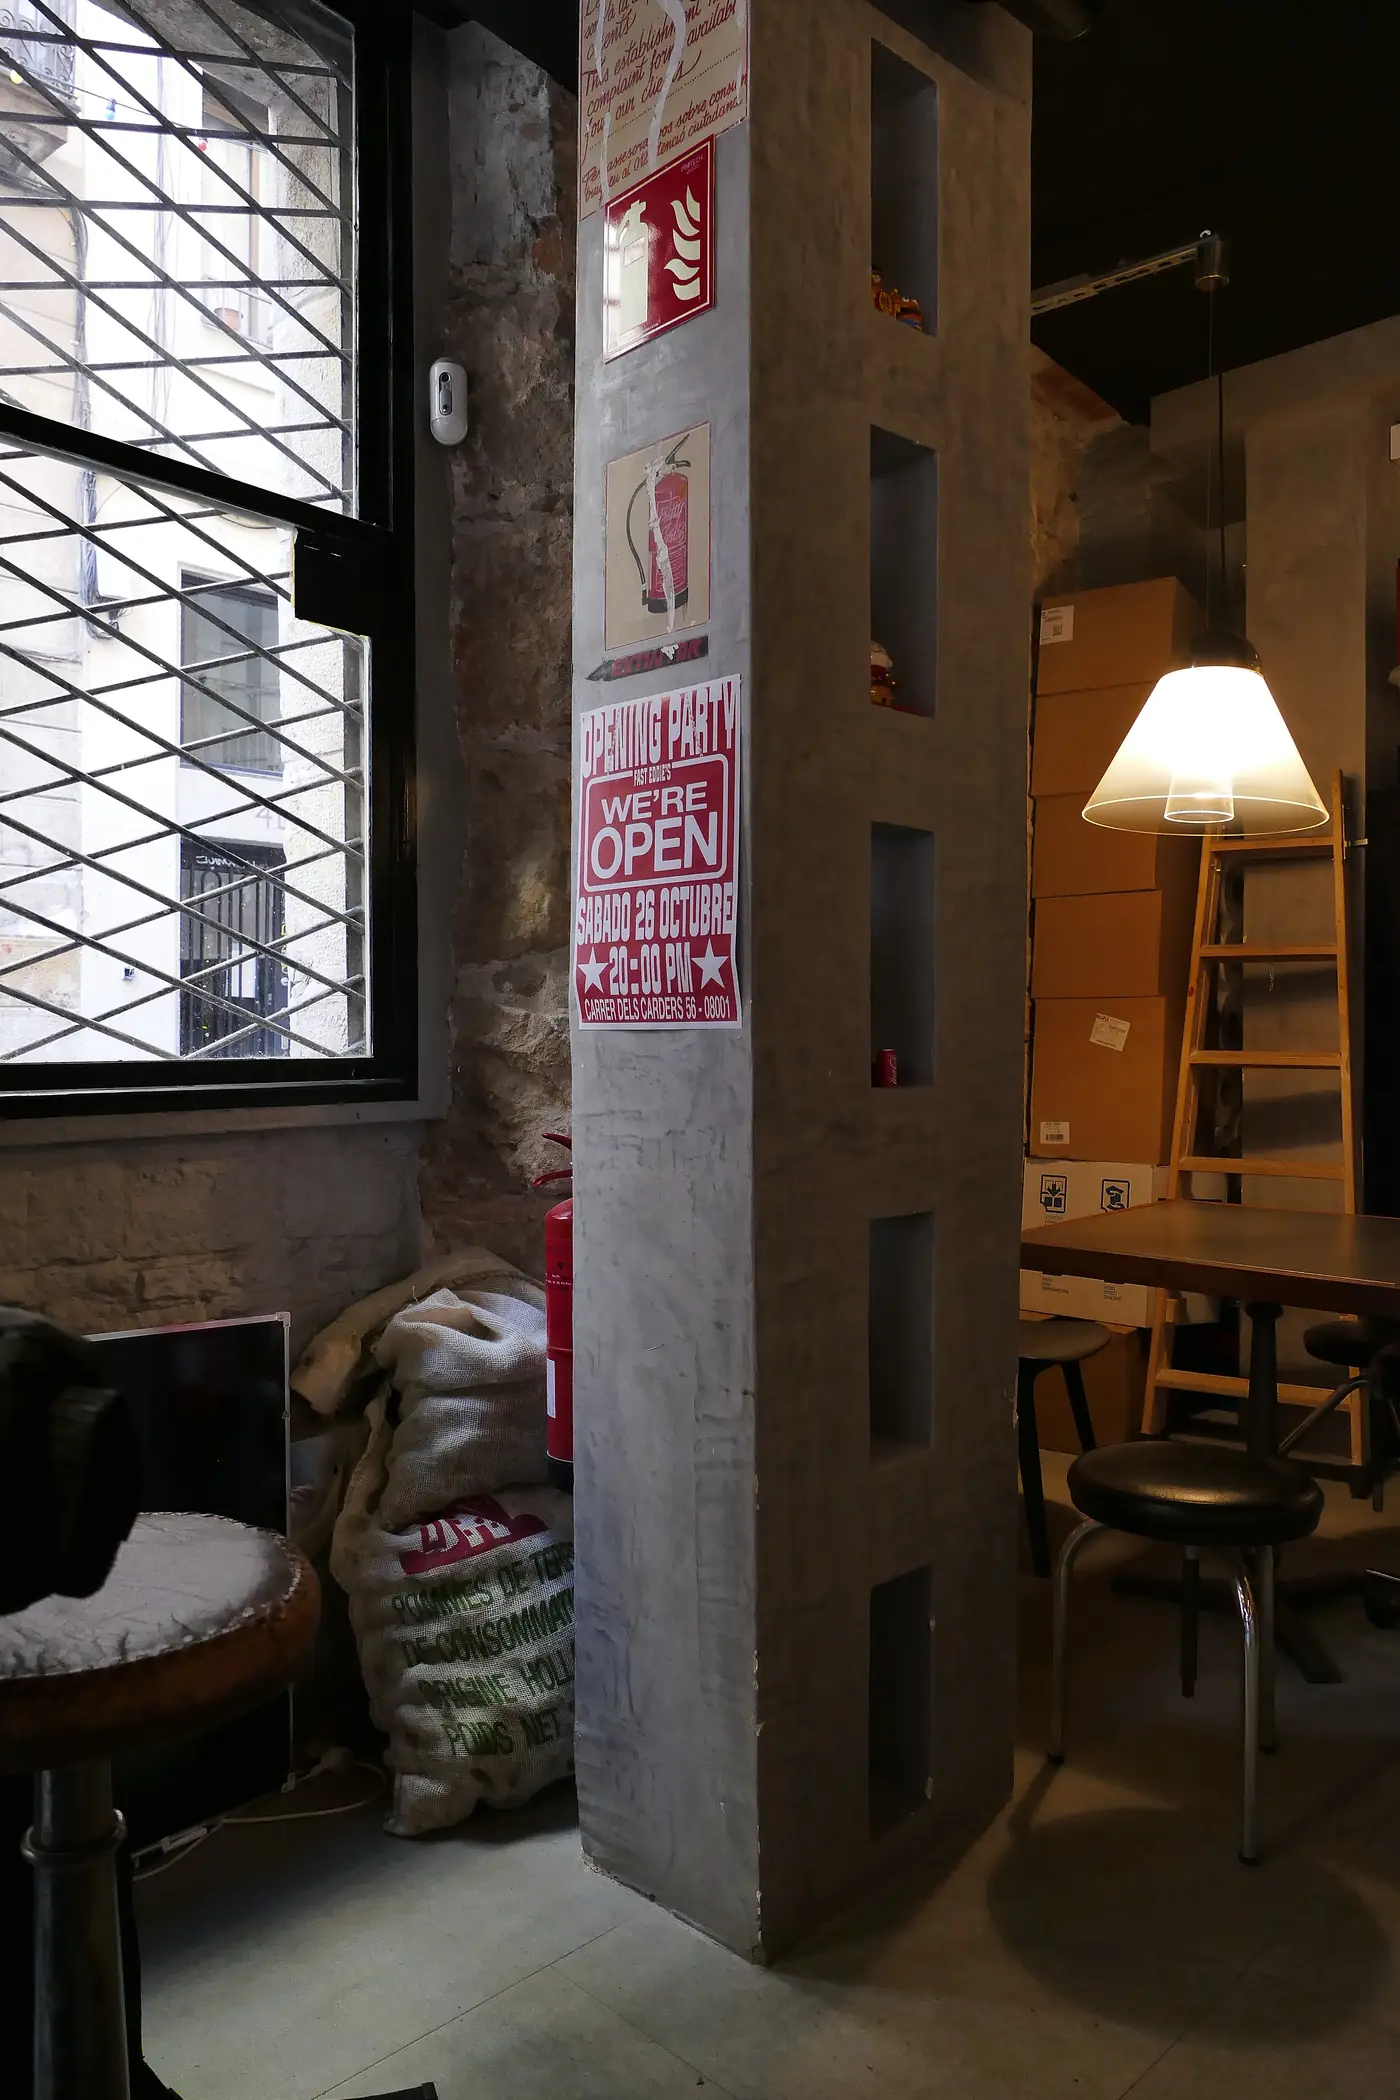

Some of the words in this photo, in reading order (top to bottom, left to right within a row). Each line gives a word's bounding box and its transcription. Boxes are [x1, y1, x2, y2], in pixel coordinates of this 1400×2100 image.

[588, 56, 649, 117] complaint
[581, 699, 663, 779] OPENING
[668, 681, 738, 760] PARTY
[600, 781, 708, 825] WE'RE
[633, 767, 648, 787] FAST
[591, 811, 718, 880] OPEN
[577, 891, 631, 945] SABADO
[635, 889, 655, 941] 26
[659, 882, 733, 939] OCTUBRE
[609, 943, 662, 996] 20:00
[665, 941, 694, 994] PM
[584, 998, 617, 1021] CARRER
[618, 997, 640, 1020] DELS
[641, 995, 684, 1020] CARDERS
[685, 995, 697, 1020] 56
[704, 995, 731, 1019] 08001
